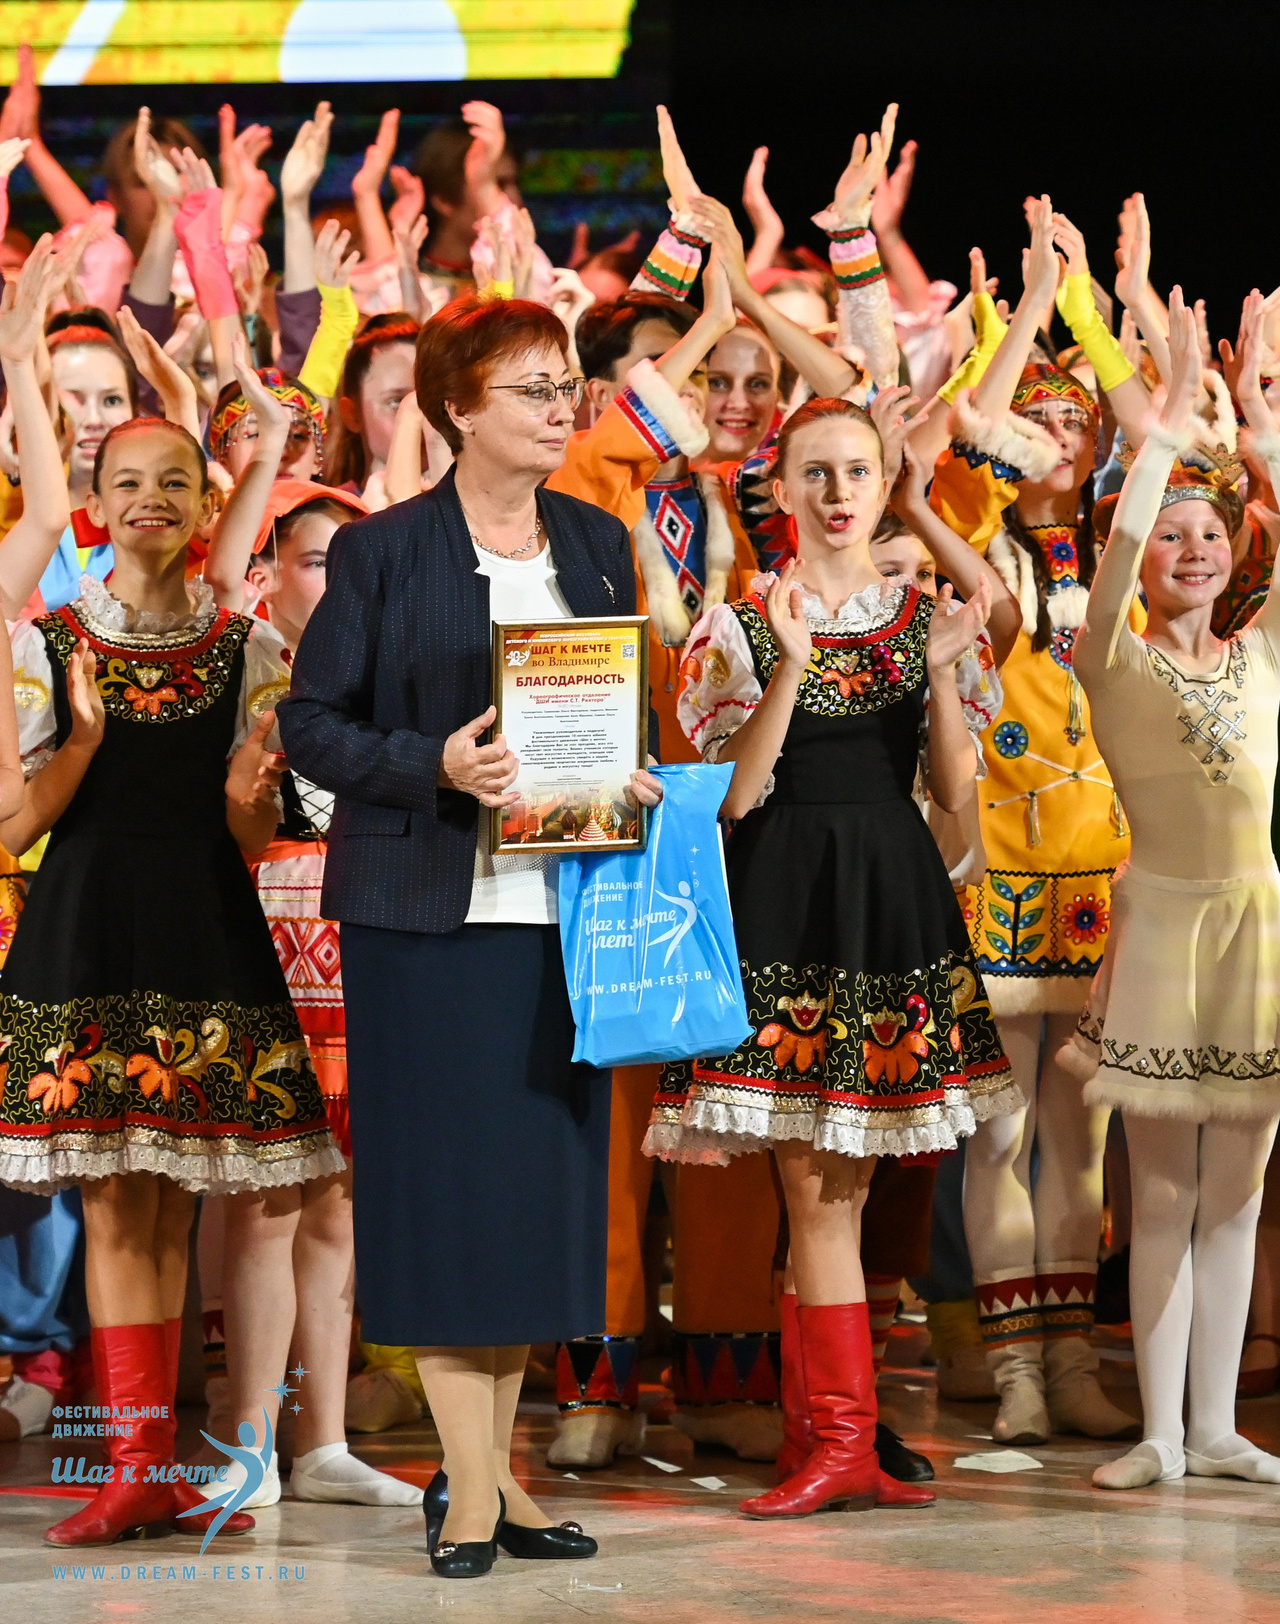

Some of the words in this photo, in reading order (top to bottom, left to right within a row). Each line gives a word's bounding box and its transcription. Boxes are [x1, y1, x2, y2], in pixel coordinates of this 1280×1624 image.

[531, 645, 556, 655] ШАГ
[560, 645, 568, 654] К
[572, 644, 611, 653] МЕЧТЕ
[516, 674, 625, 687] БЛАГОДАРНОСТЬ
[616, 919, 627, 931] к
[630, 909, 676, 930] мчте
[587, 970, 712, 996] WW.DREAM-FEST.RU
